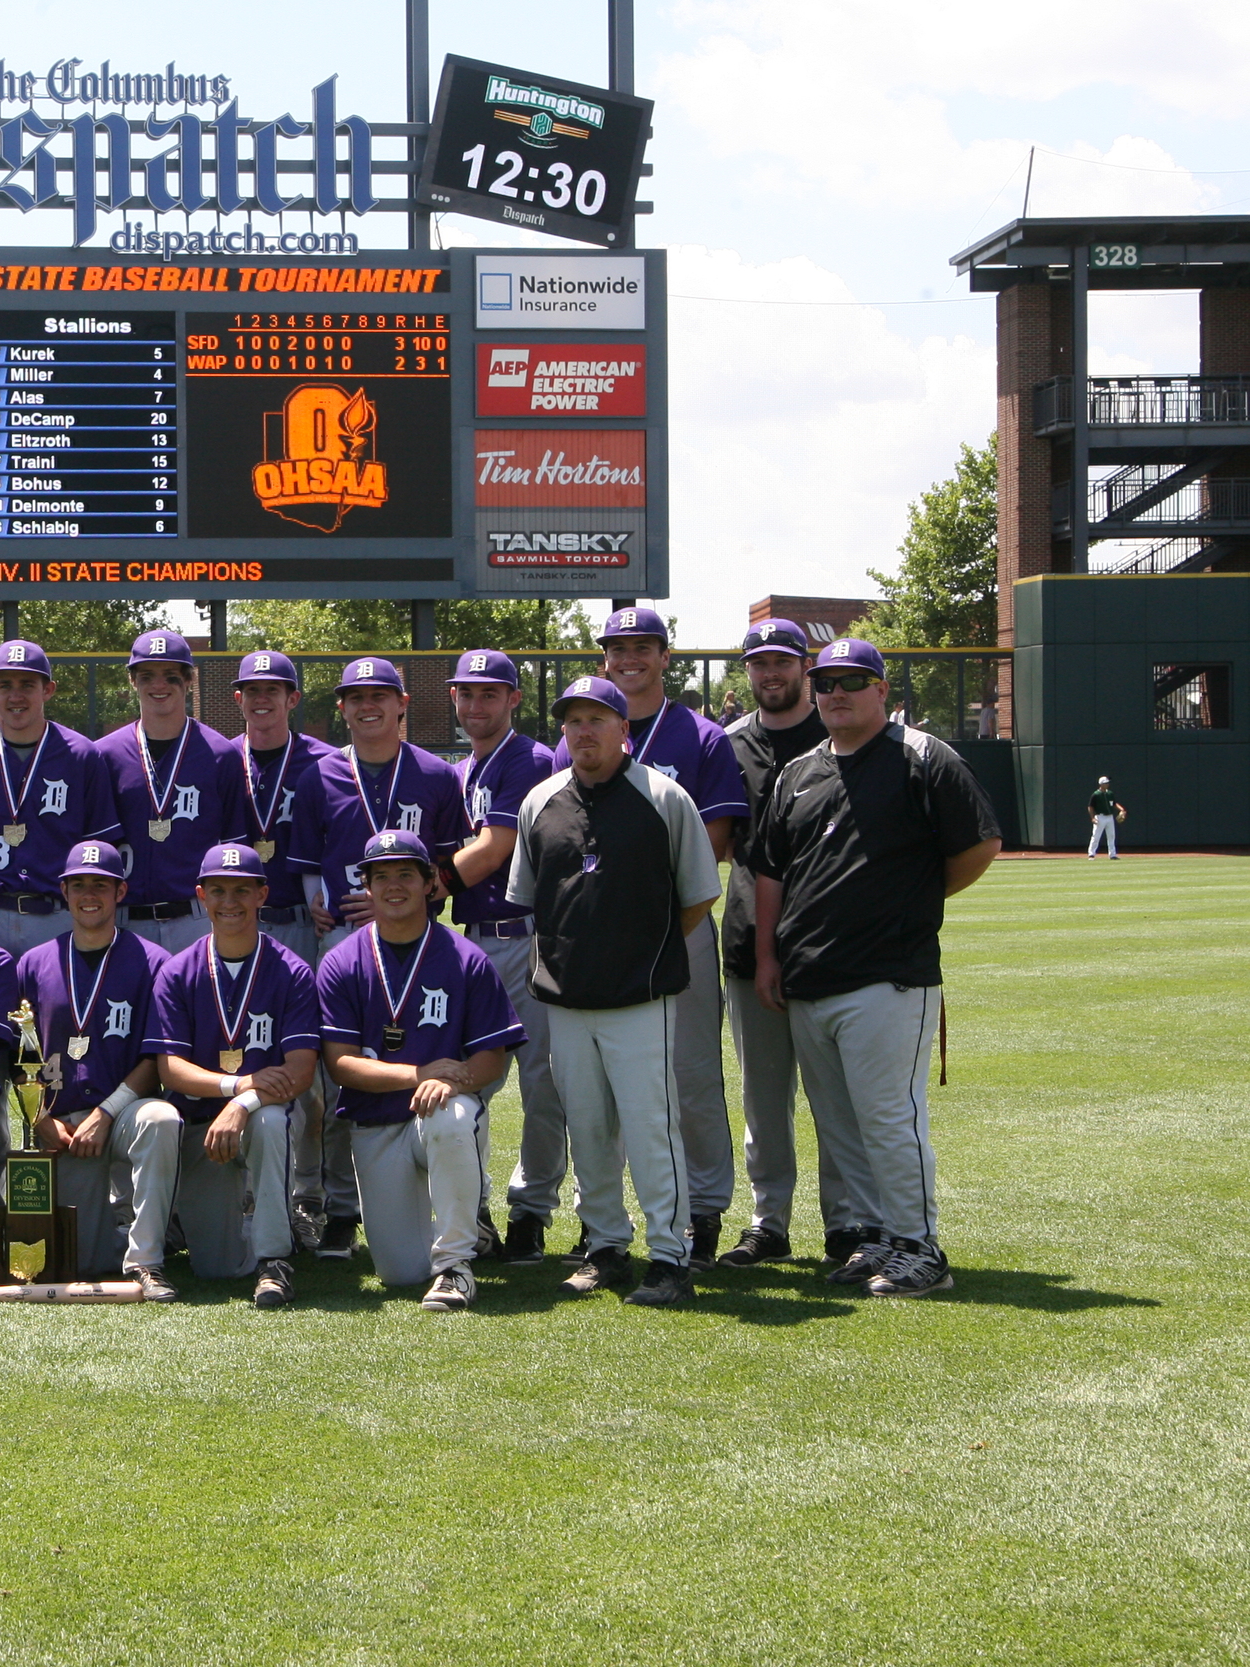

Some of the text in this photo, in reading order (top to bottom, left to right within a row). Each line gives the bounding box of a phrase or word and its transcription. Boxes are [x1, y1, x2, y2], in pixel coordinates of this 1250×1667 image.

[46, 57, 232, 106] Columbus
[488, 77, 606, 127] Huntington
[462, 143, 606, 216] 12:30
[502, 204, 546, 226] Dispatch
[110, 221, 359, 262] dispatch.com
[1094, 246, 1138, 266] 328
[81, 266, 228, 292] BASEBALL
[239, 268, 442, 293] TOURNAMENT
[519, 275, 638, 294] Nationwide
[520, 298, 597, 311] Insurance
[44, 318, 132, 334] Stallions
[235, 315, 444, 328] 1 2 3 4 5 6 7 8 9 R H E
[187, 336, 446, 350] SFD 1 0 0 2 0 0 0 3 10 0
[10, 347, 55, 361] Kurek
[154, 348, 163, 360] 5
[187, 355, 445, 370] WAP 0 0 0 1 0 1 0 2 3 1
[10, 368, 53, 381] Miller
[153, 369, 162, 380] 4
[490, 361, 528, 375] AEP
[533, 361, 636, 376] AMERICAN
[532, 378, 615, 393] ELECTRIC
[10, 391, 44, 404] Alas
[154, 391, 163, 403] 7
[531, 395, 599, 410] POWER
[11, 412, 75, 429] DeCamp
[151, 413, 167, 424] 20
[151, 434, 167, 445] 13
[11, 456, 55, 469] Traini
[152, 456, 167, 467] 15
[476, 449, 641, 485] Tim Hortons
[11, 477, 62, 490] Bohus
[152, 477, 168, 489] 12
[254, 459, 386, 499] OHSAA
[12, 499, 84, 512] Delmonte
[155, 499, 164, 511] 9
[155, 521, 164, 532] 6
[489, 533, 629, 551] TANSKY
[497, 555, 620, 563] SAWMILL TOYOTA
[30, 562, 41, 581] II
[47, 562, 120, 581] STATE
[126, 562, 263, 581] CHAMPIONS
[170, 784, 200, 822] D
[81, 846, 100, 864] D
[222, 848, 241, 867] D
[417, 984, 449, 1028] D
[103, 998, 133, 1039] D
[245, 1010, 274, 1053] D
